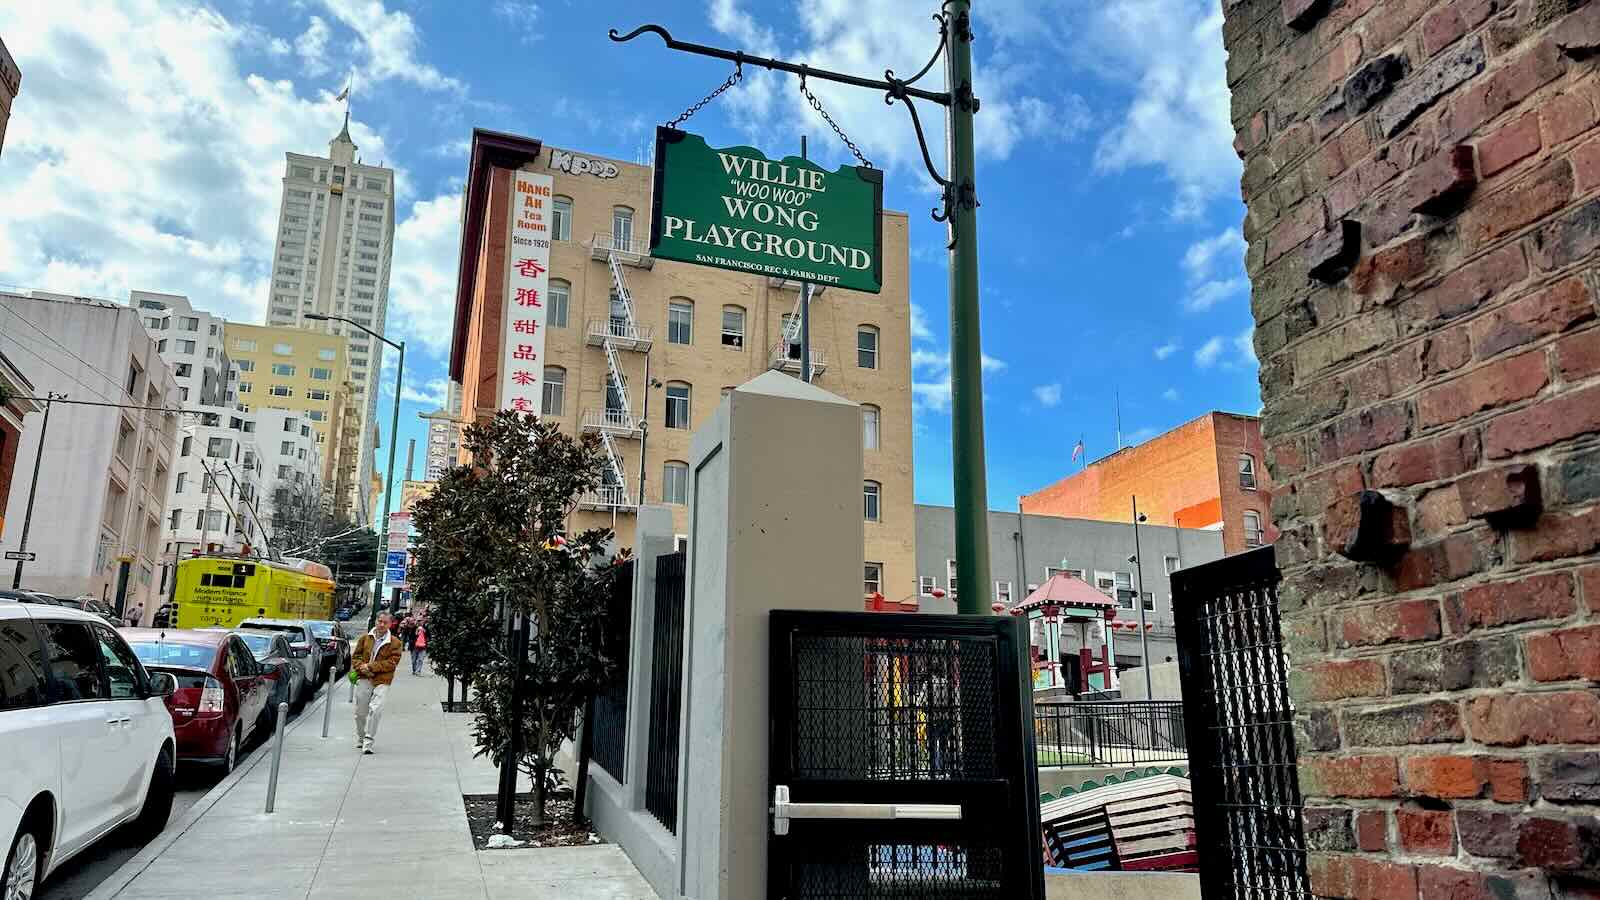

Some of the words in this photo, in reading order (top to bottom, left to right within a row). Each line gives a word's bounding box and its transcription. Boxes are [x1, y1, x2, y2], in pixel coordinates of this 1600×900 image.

[718, 153, 825, 192] WILLIE
[517, 180, 550, 197] HANG
[731, 179, 770, 200] “WOO
[772, 188, 812, 206] WOO”
[524, 196, 543, 209] AH
[721, 196, 819, 231] WONG
[517, 220, 547, 232] Room
[524, 210, 542, 220] Tea
[513, 236, 533, 246] Since
[533, 239, 549, 249] 1920
[663, 215, 871, 270] PLAYGROUND
[696, 254, 714, 264] SAN
[714, 256, 763, 271] FRANCISCO
[764, 265, 782, 274] REC
[782, 267, 789, 276] &
[790, 269, 816, 280] PARKS
[817, 273, 840, 284] DEPT
[511, 257, 546, 416] 香雅甜品茶室
[241, 565, 247, 573] 1
